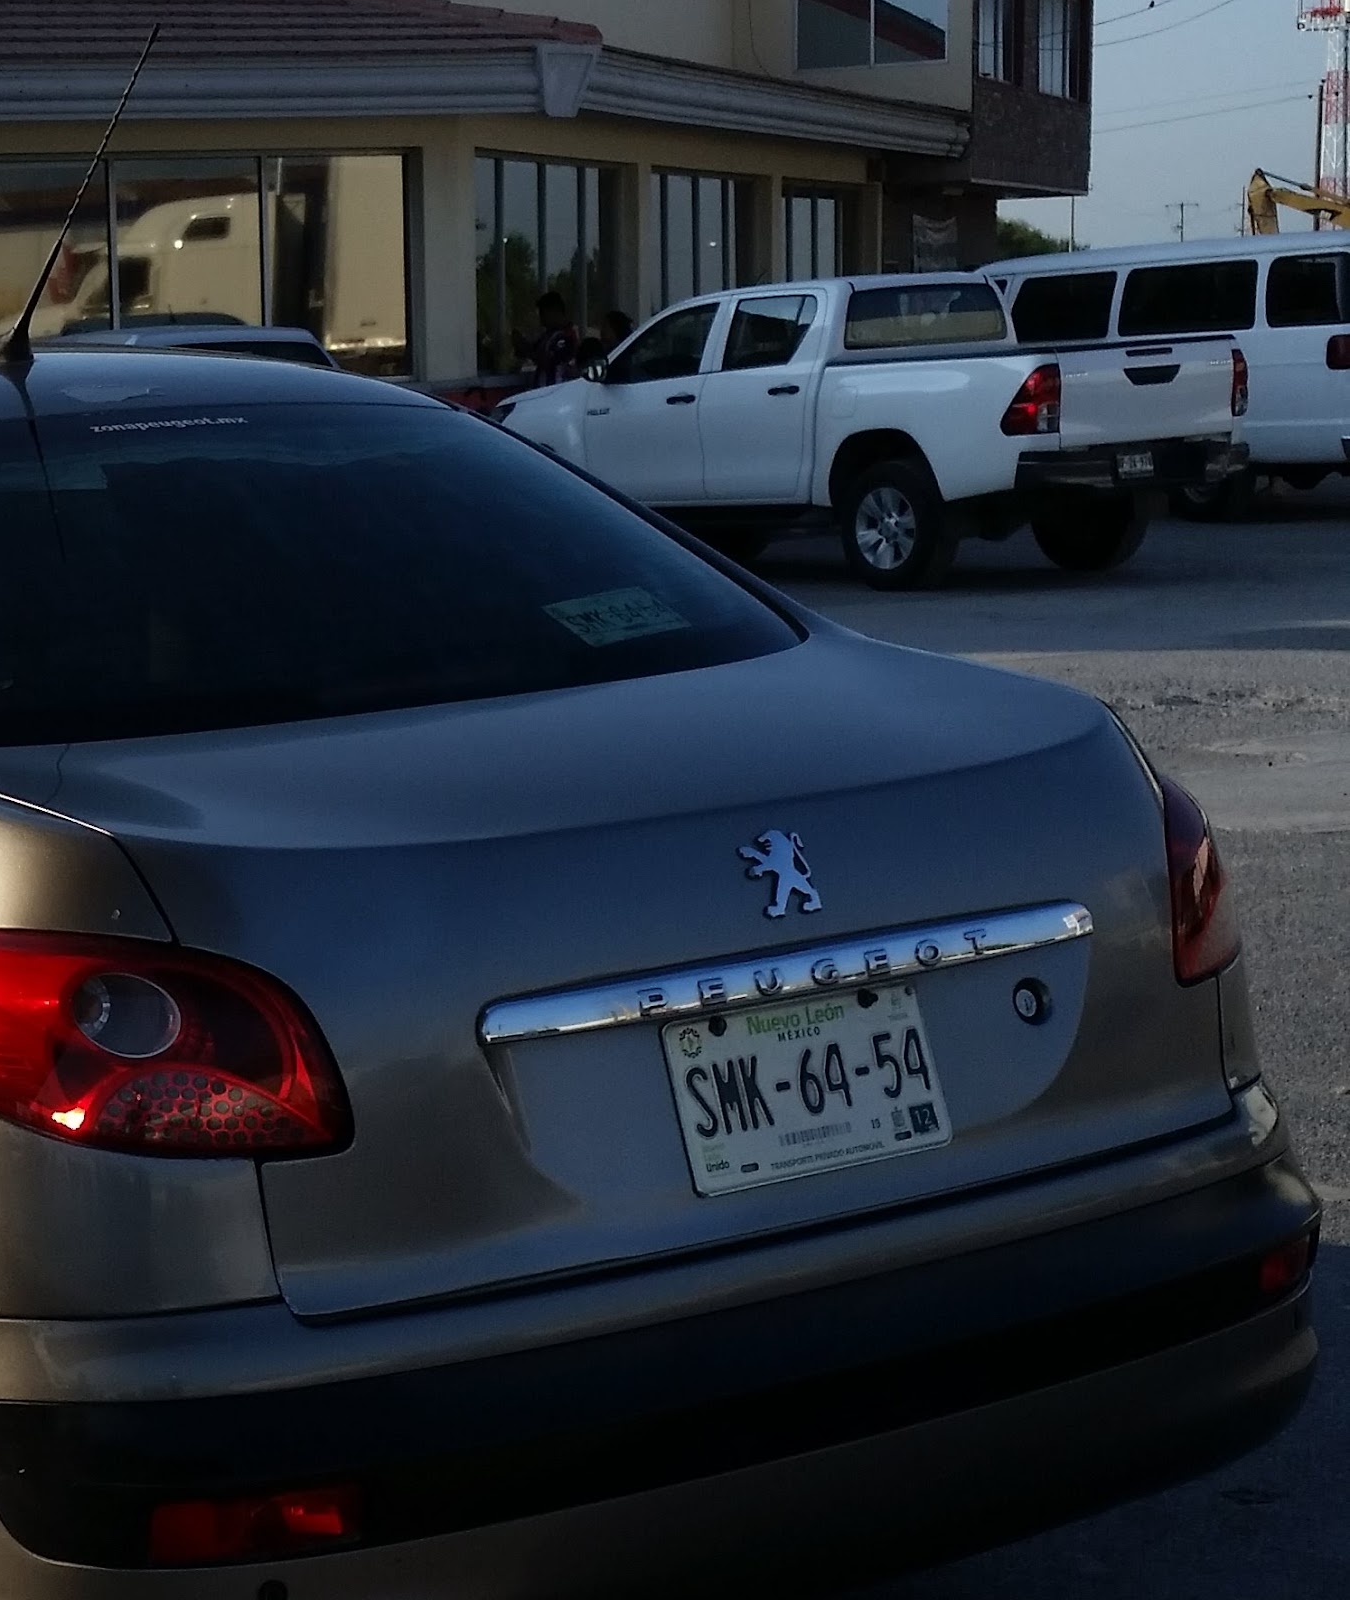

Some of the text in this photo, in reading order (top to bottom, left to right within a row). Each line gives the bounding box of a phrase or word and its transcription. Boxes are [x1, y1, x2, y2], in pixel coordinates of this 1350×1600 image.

[89, 416, 249, 434] zonapeugeot.mx
[636, 928, 988, 1017] PEUGEOT
[746, 1002, 845, 1036] Nuevo León
[685, 1027, 931, 1138] SMK-64-54
